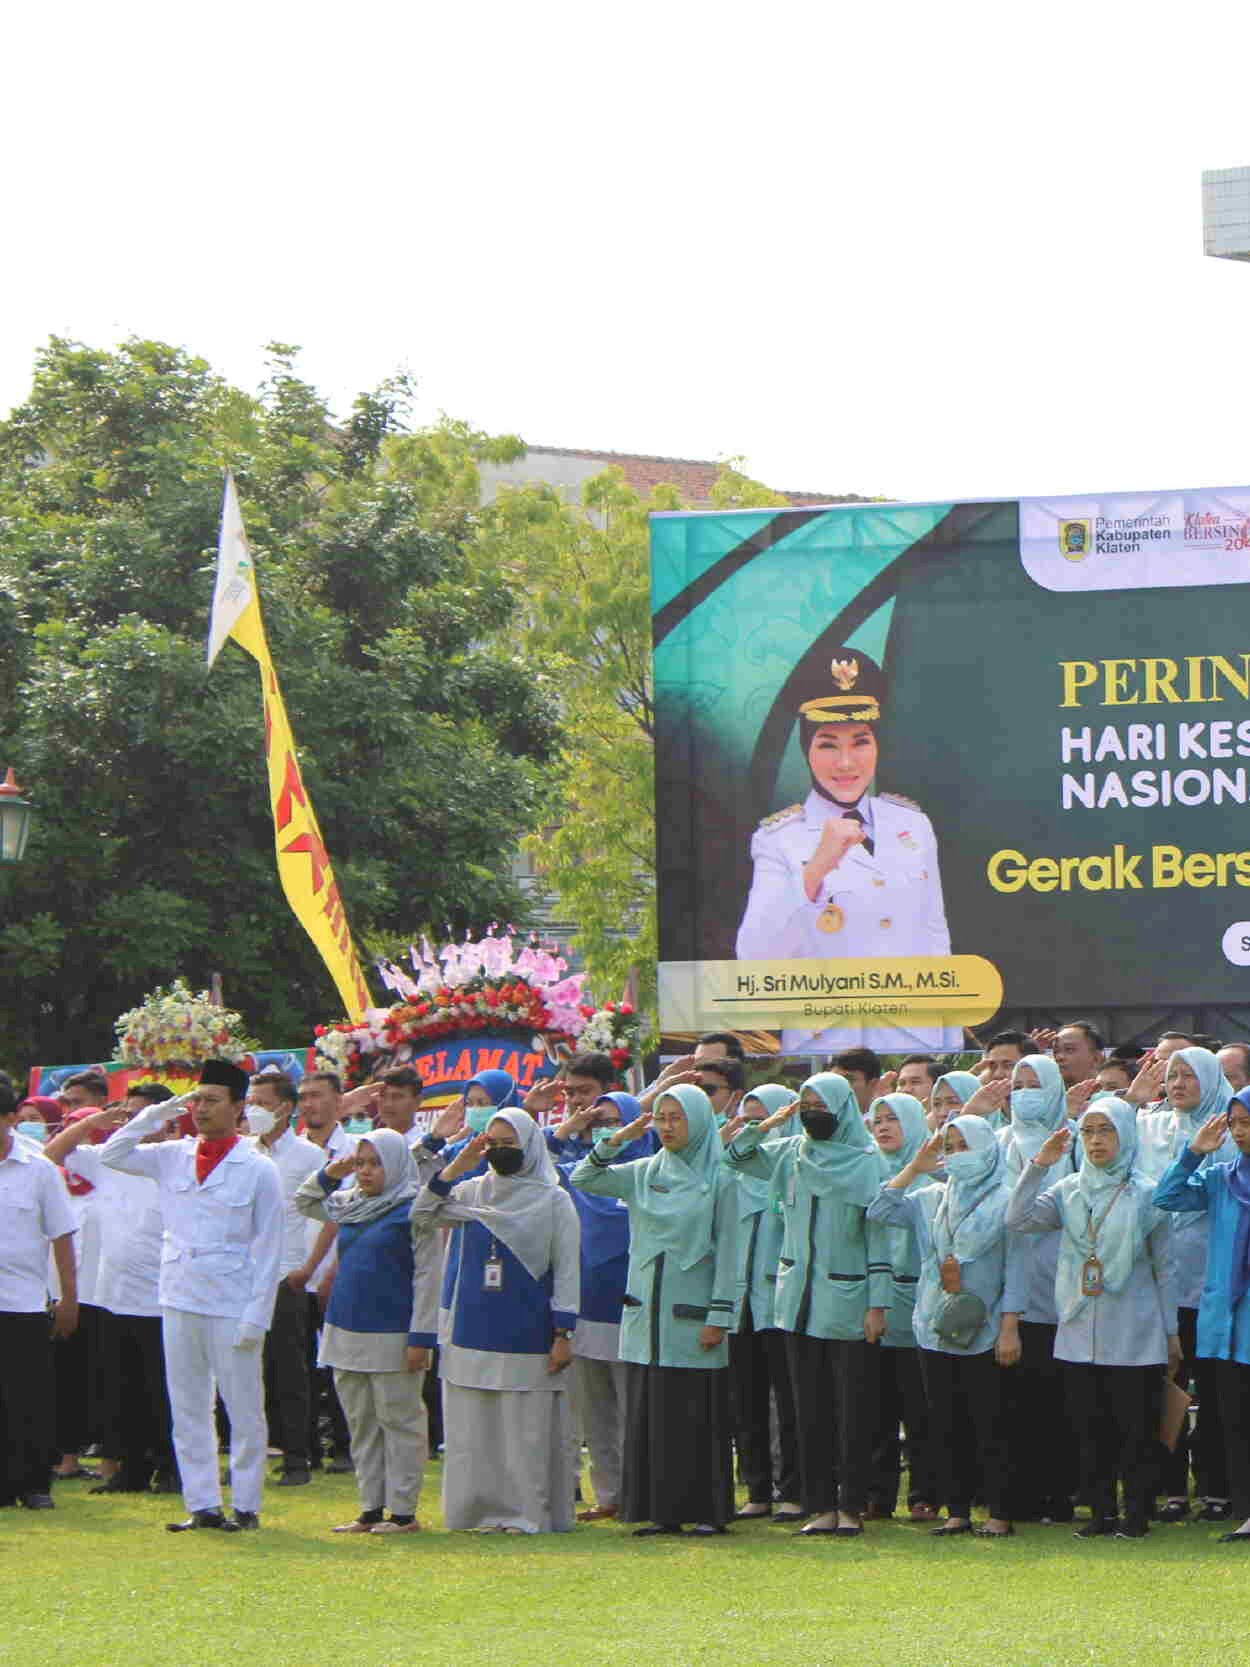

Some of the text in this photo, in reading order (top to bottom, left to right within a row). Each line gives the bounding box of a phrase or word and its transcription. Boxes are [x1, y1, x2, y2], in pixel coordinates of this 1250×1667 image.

[1096, 516, 1170, 529] Pemerintah
[1096, 528, 1171, 543] Kabupaten
[1096, 541, 1140, 554] Klaten
[1061, 722, 1166, 763] HARI
[986, 844, 1144, 893] Gerak
[737, 970, 960, 996] Hj. Sri Mulyani S.M., M.Si.
[803, 1003, 908, 1018] Bupati Klaten
[415, 1048, 545, 1088] ELAMAT
